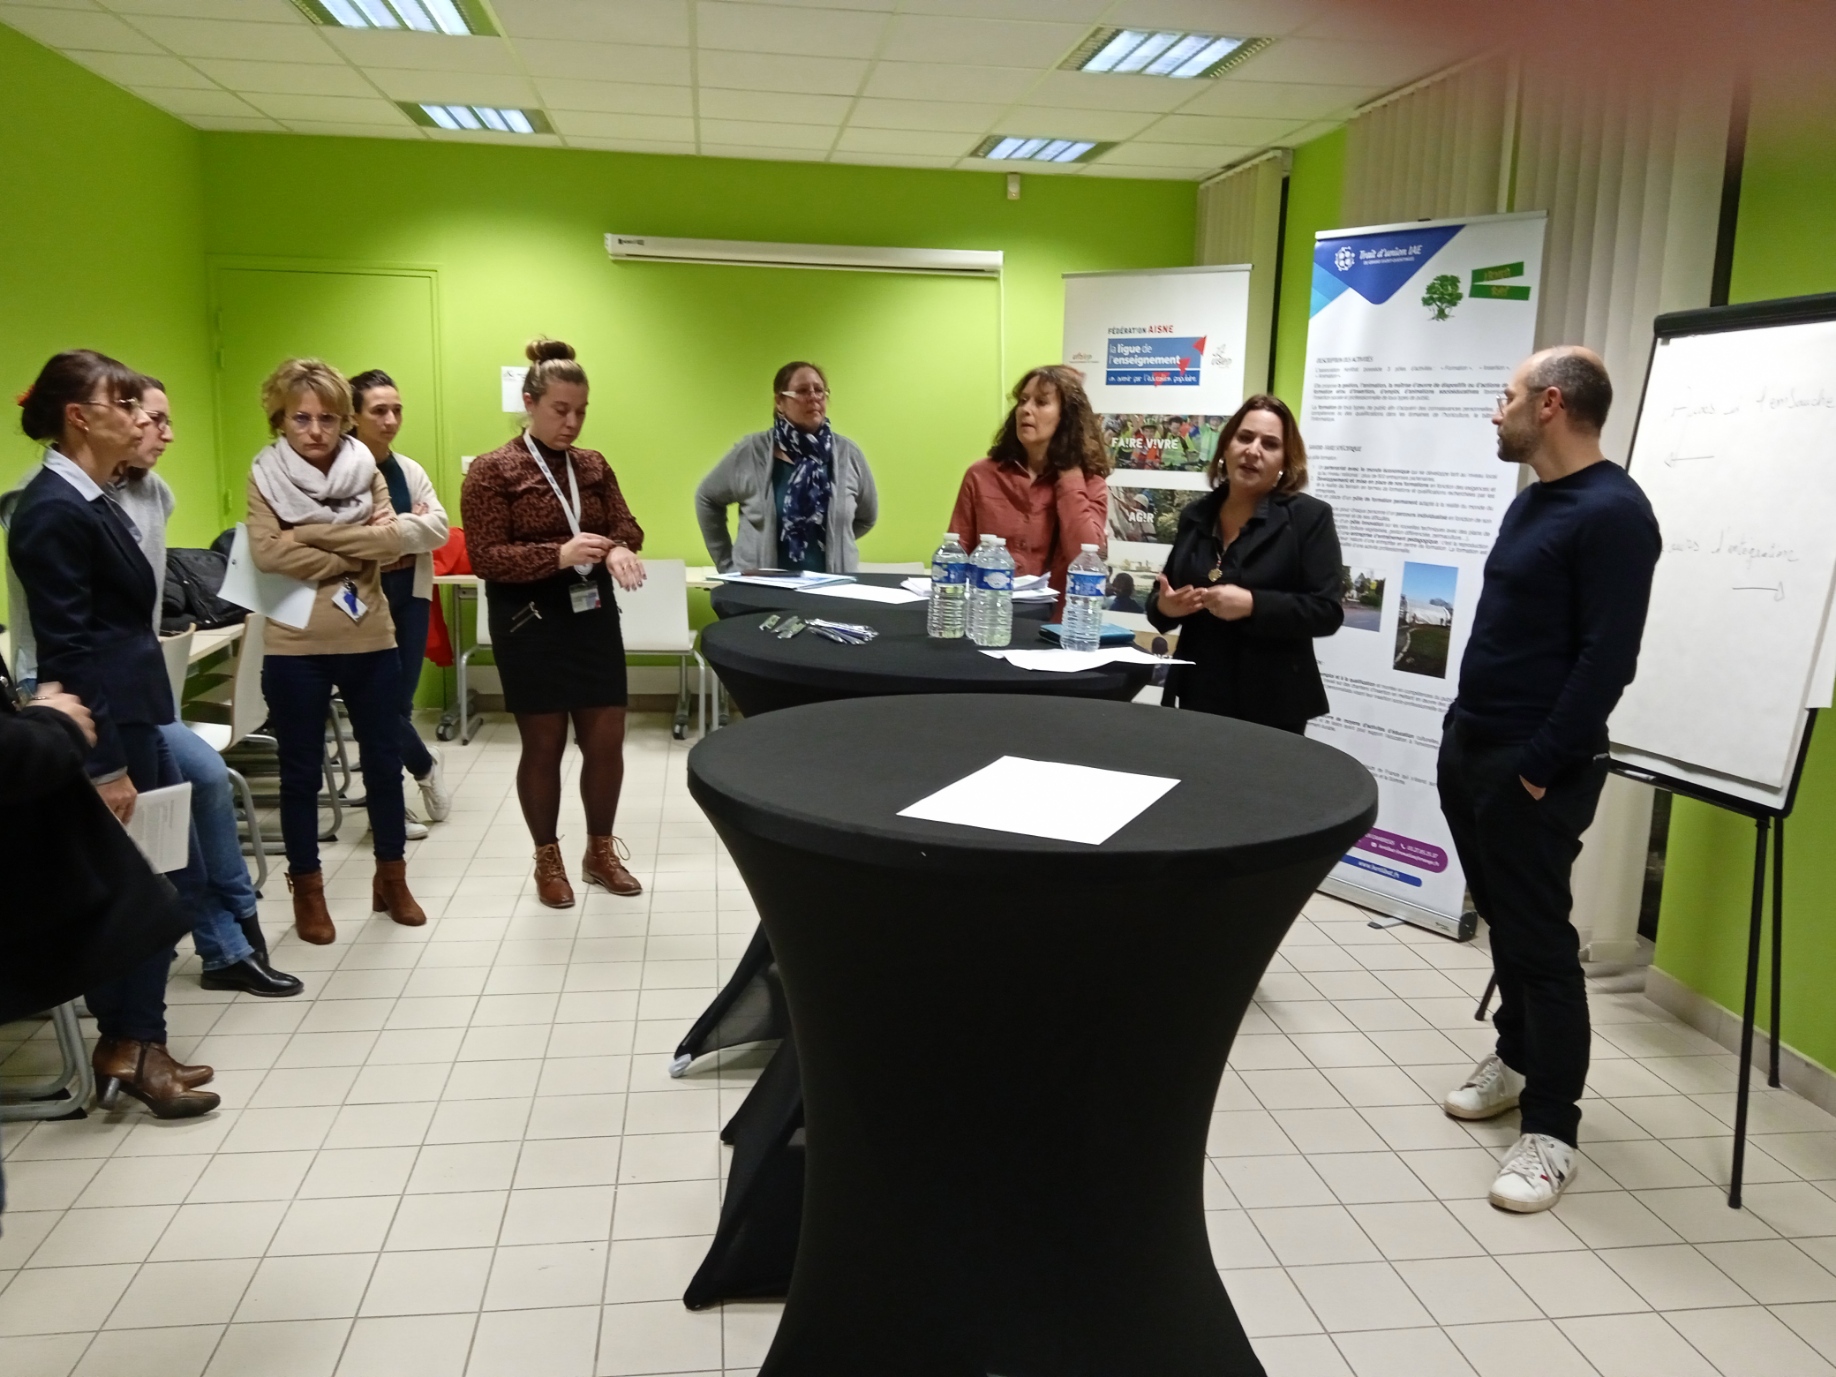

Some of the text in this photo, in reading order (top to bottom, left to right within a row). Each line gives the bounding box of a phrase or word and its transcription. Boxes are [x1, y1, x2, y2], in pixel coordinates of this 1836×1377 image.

[1148, 324, 1174, 334] AISNE
[1110, 343, 1152, 355] la ligue de
[1108, 354, 1181, 367] l'enseignement
